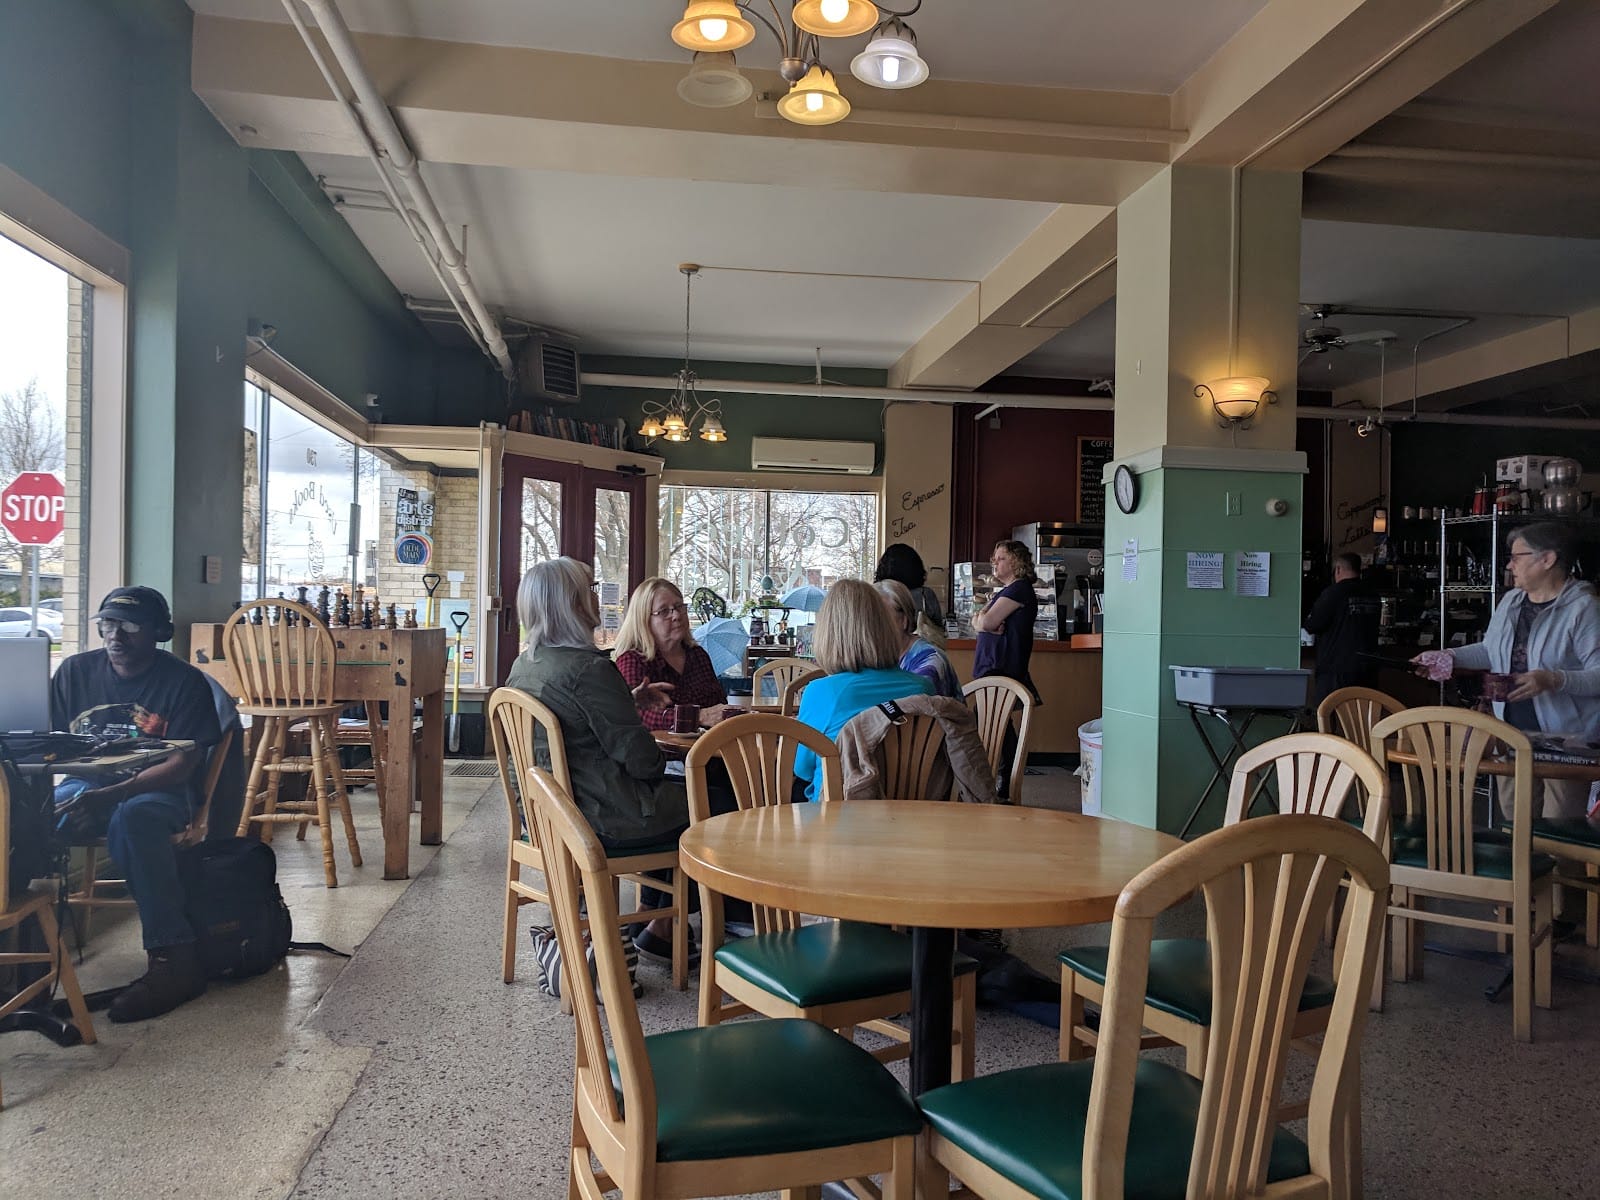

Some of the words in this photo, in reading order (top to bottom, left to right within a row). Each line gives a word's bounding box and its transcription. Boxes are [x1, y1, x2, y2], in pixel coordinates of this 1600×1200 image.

[902, 483, 944, 511] Espresso
[4, 494, 64, 522] STOP
[398, 500, 433, 516] arts
[892, 517, 916, 538] Tea
[1240, 560, 1262, 568] Hiring
